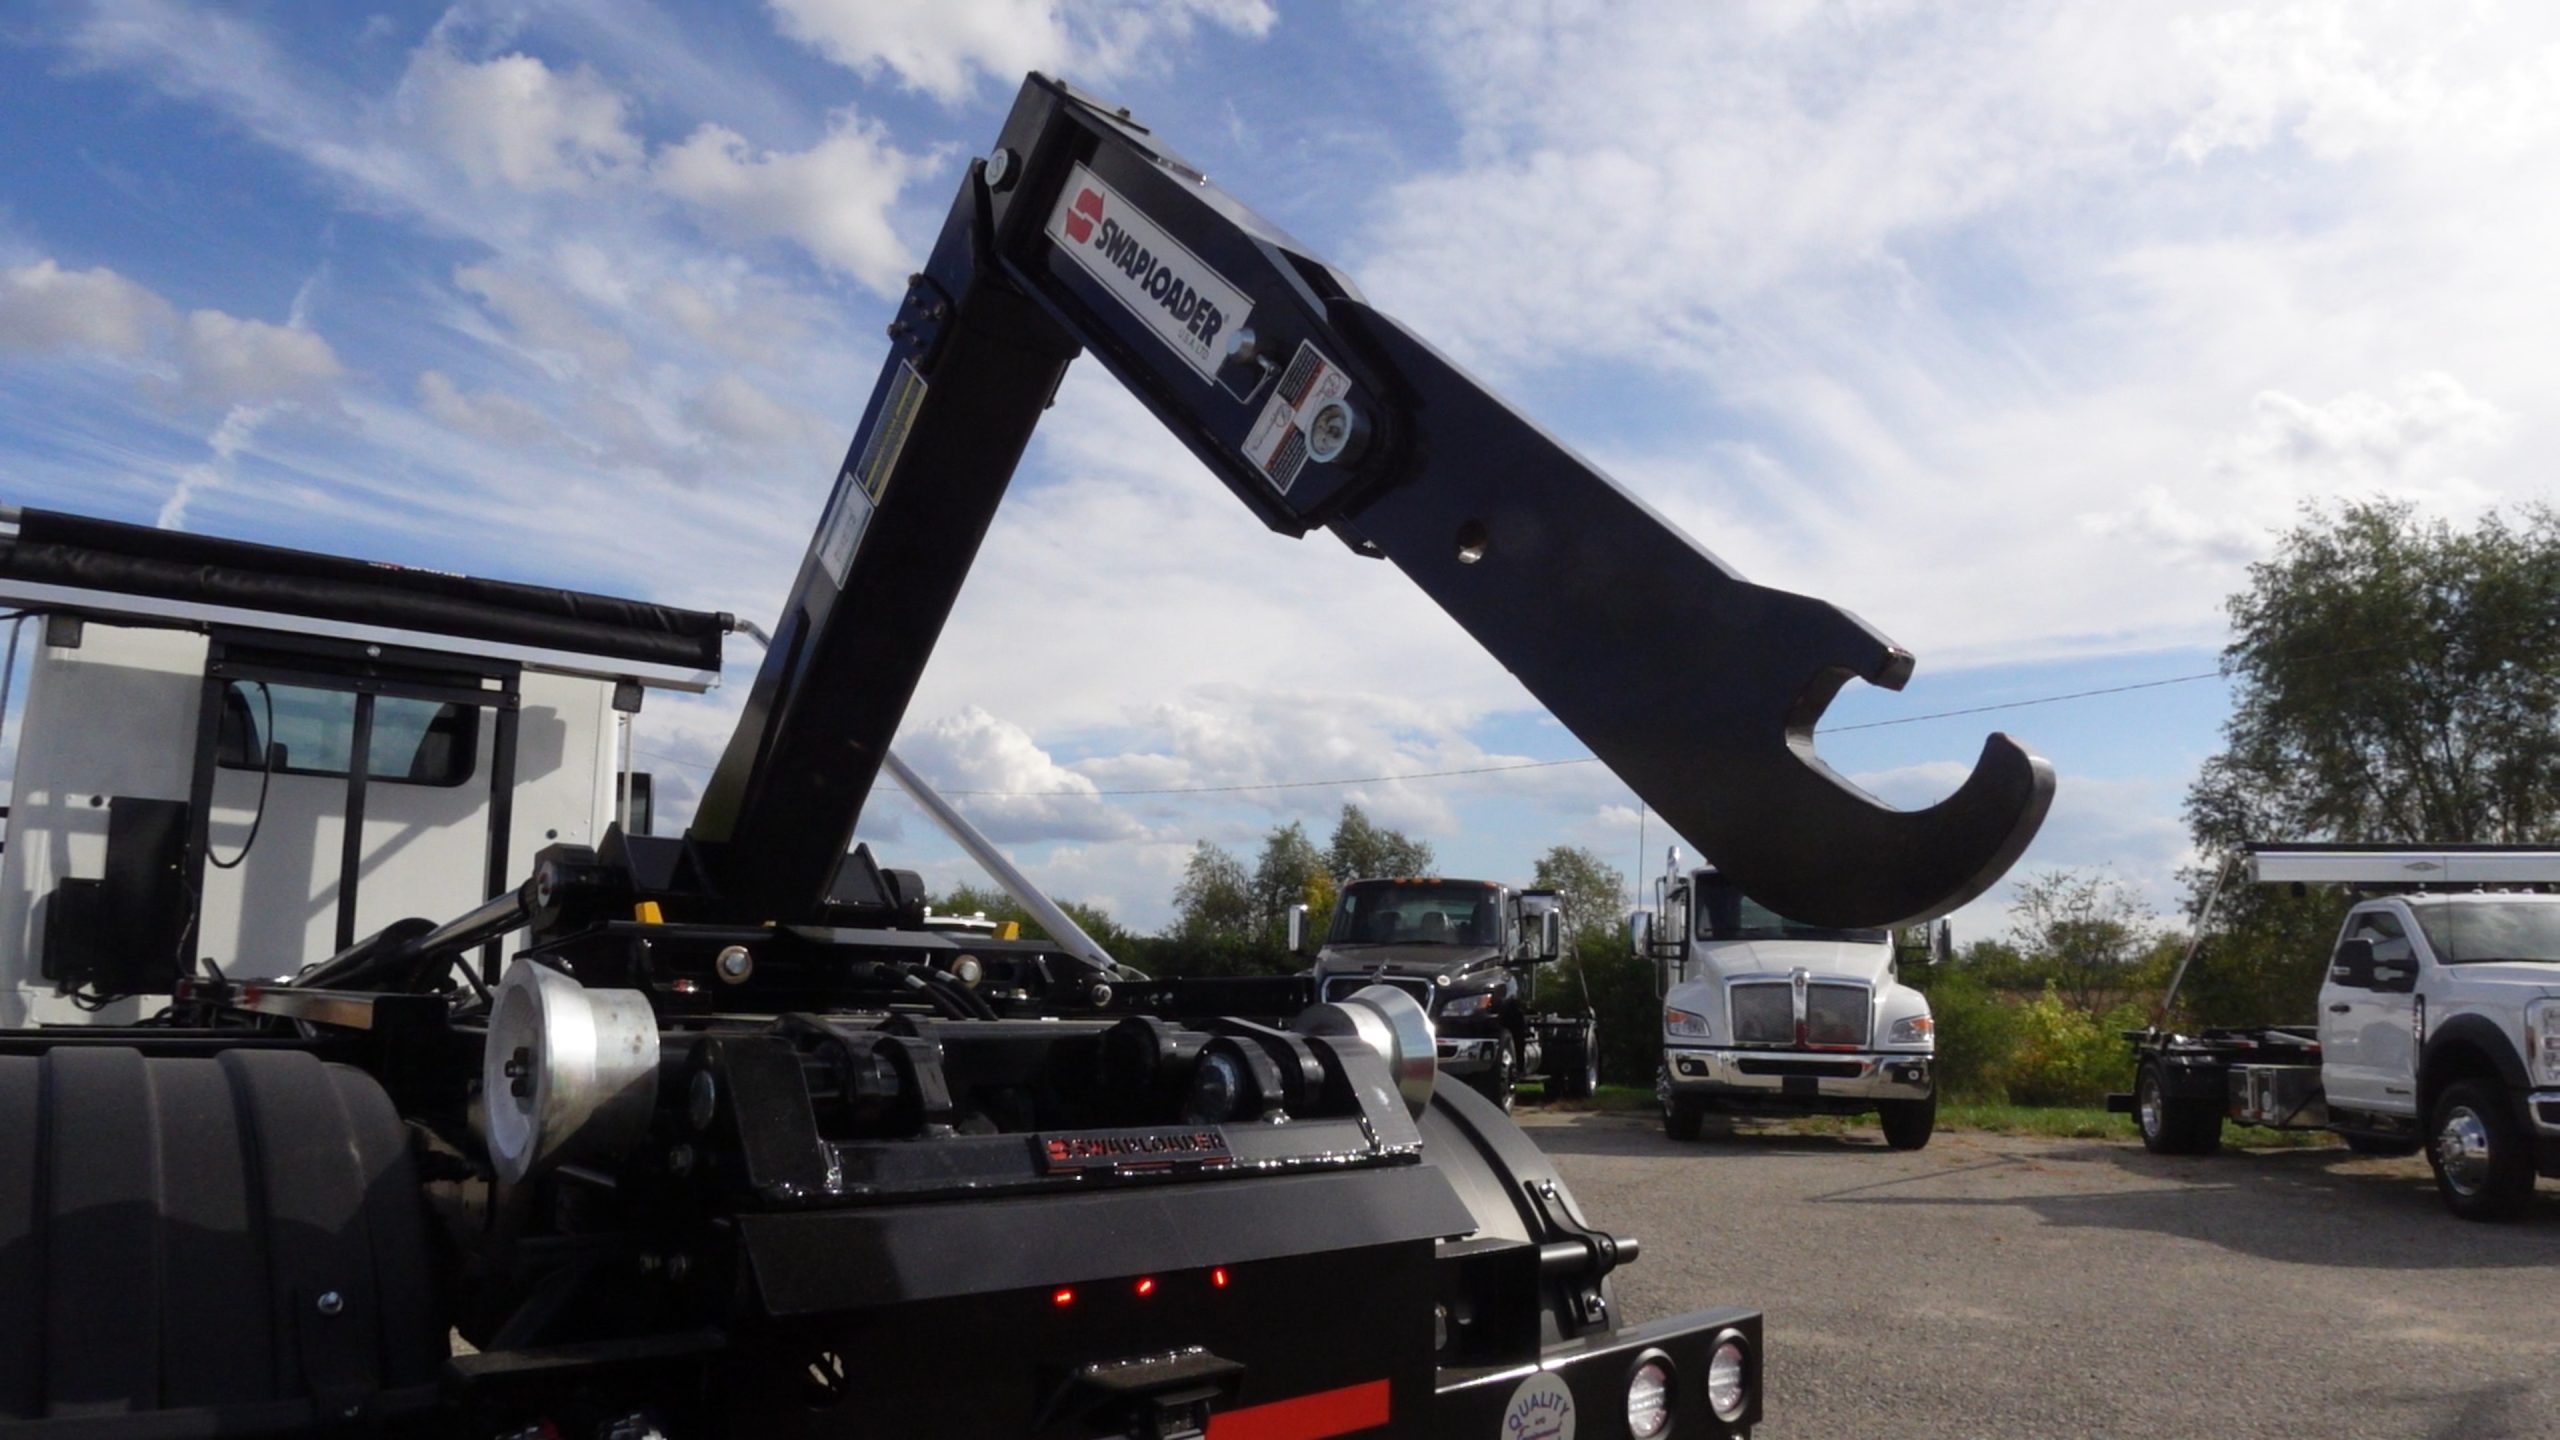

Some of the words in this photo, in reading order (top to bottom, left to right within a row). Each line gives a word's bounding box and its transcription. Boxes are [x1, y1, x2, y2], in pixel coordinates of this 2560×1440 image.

[1094, 217, 1222, 348] SWAPLOADER
[1072, 1132, 1225, 1157] SWAPLOADER
[1508, 1391, 1570, 1431] QUALITY
